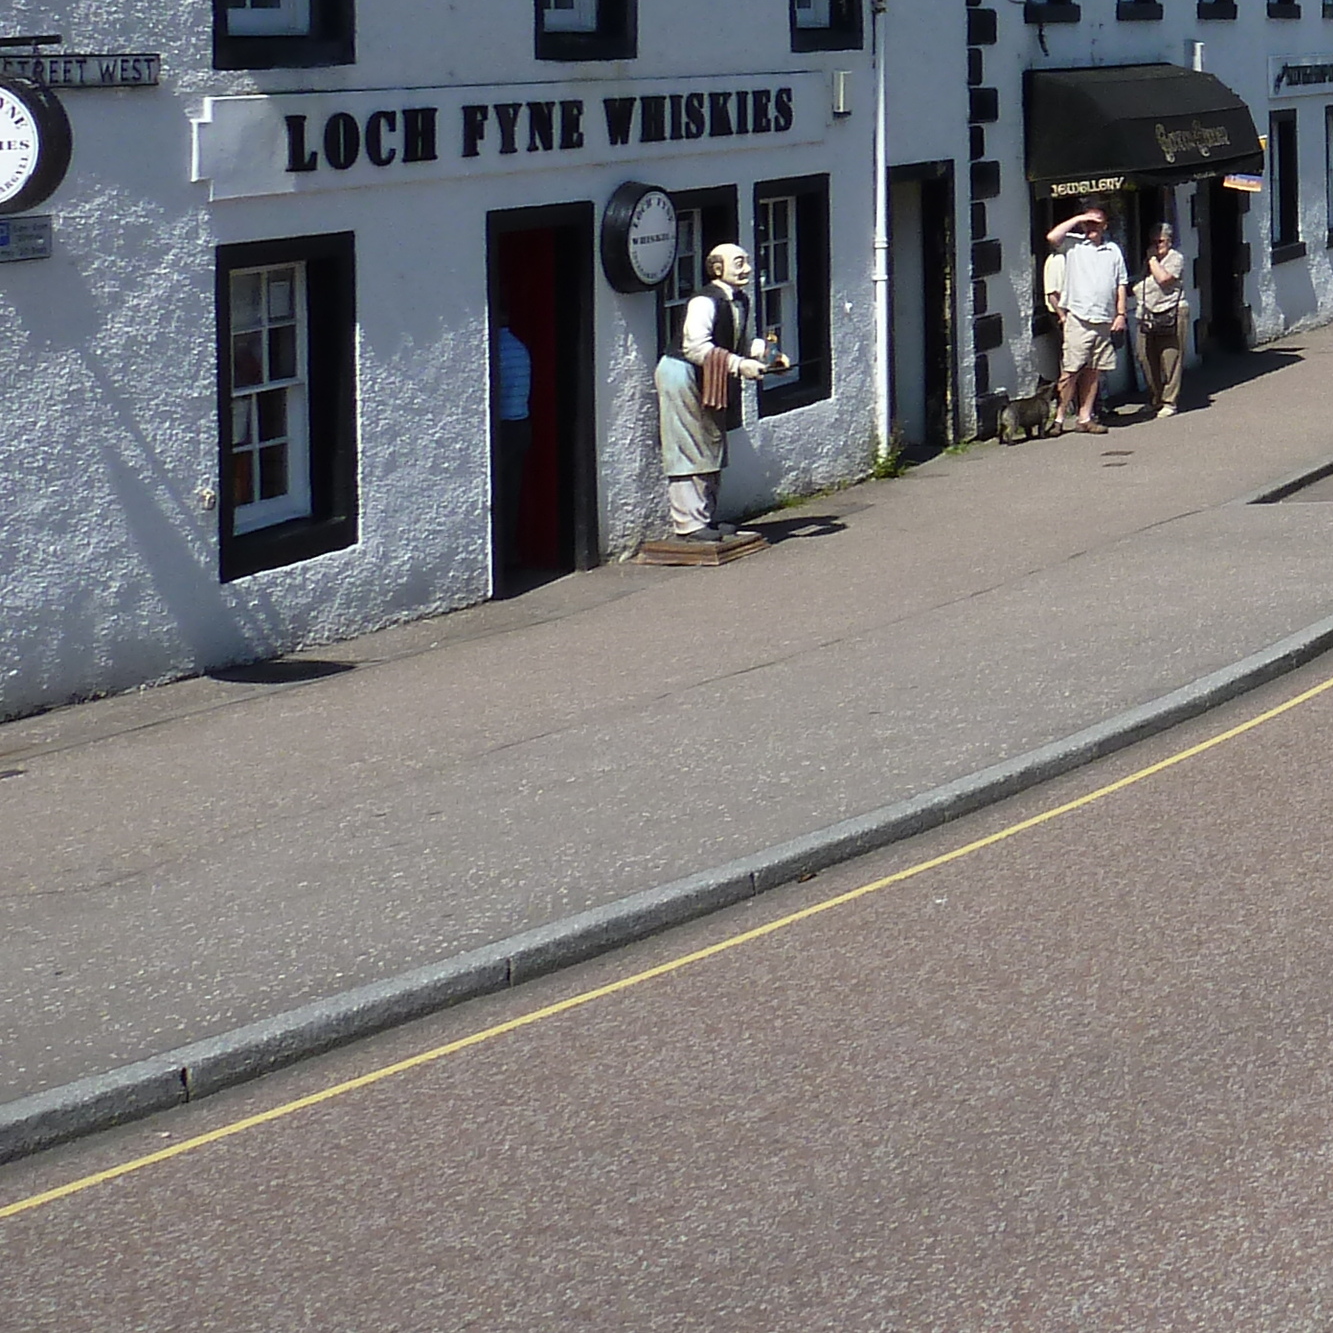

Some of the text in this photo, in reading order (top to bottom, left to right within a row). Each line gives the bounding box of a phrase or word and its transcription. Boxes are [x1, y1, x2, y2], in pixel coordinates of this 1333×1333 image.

[98, 58, 156, 83] WEST
[284, 87, 794, 173] LOCH FYNE WHISKIES
